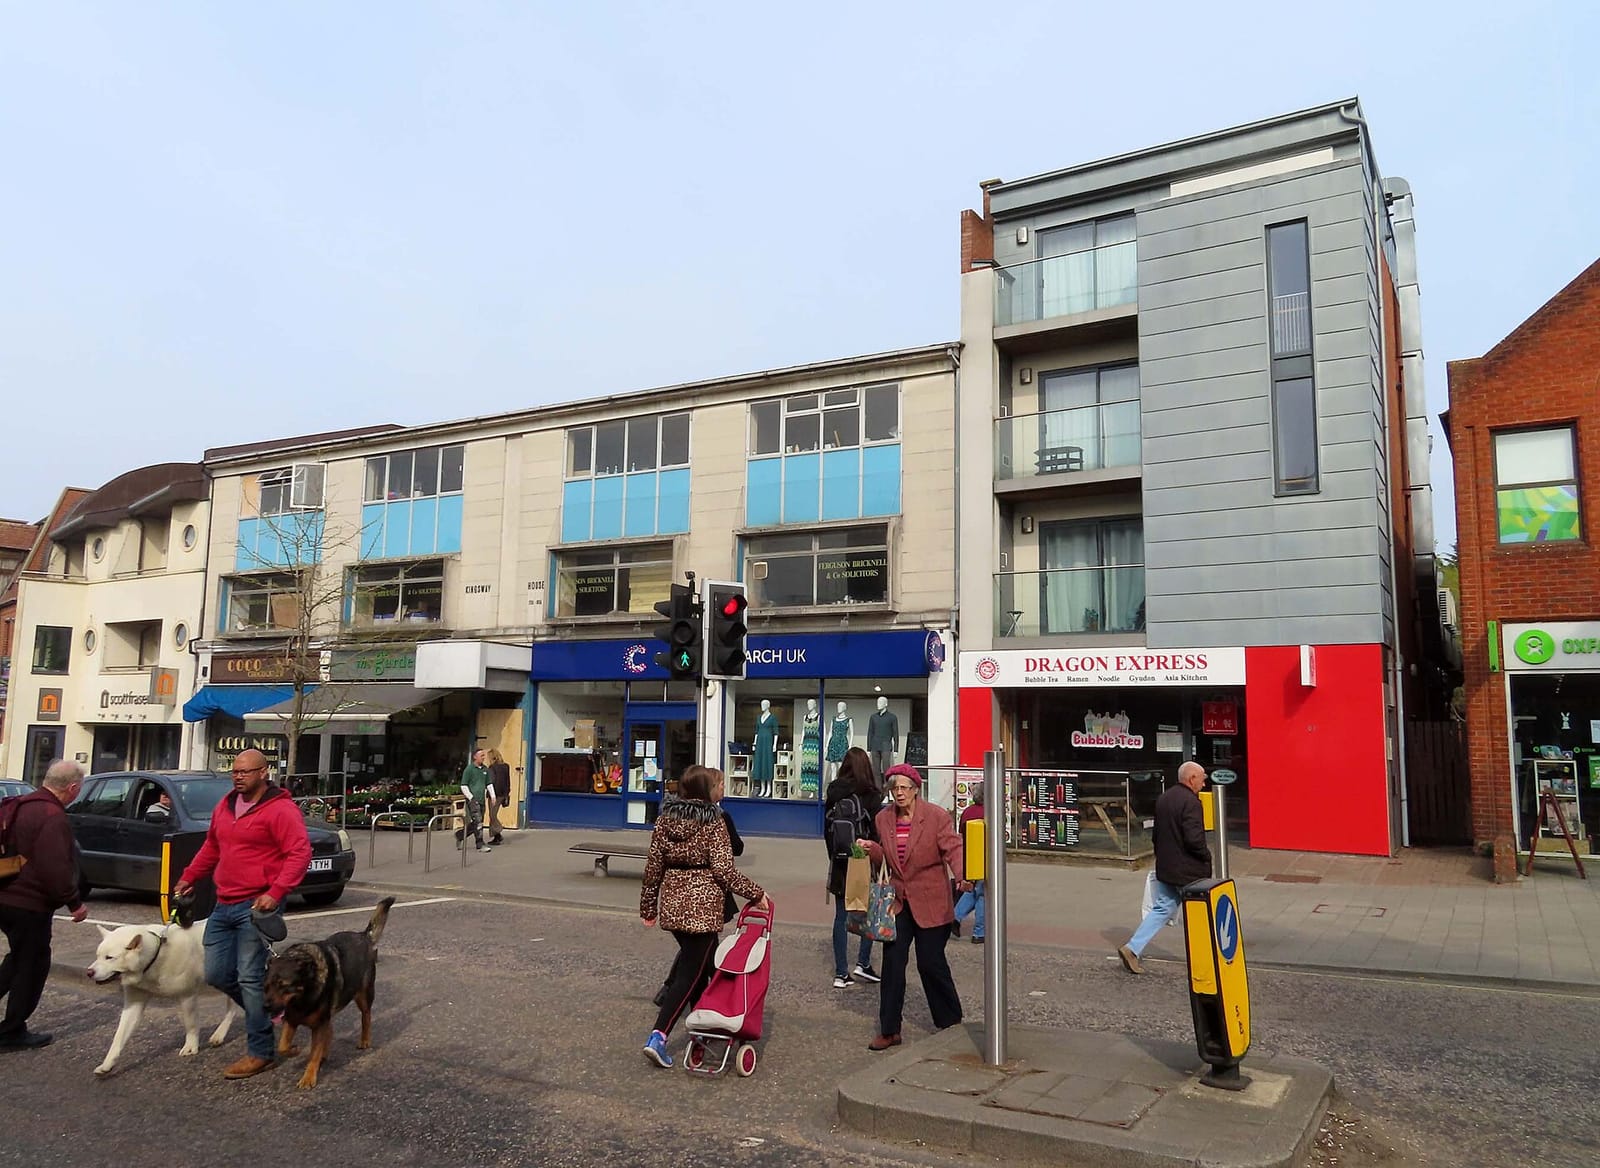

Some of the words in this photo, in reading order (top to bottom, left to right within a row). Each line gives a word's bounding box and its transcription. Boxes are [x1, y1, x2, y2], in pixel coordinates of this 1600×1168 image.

[818, 560, 851, 570] FERGUSON
[852, 558, 887, 568] BRICKNELL
[841, 569, 879, 579] SOLICITORS
[465, 585, 491, 593] KINGSWAY
[528, 581, 545, 590] HOUSE
[1562, 638, 1600, 655] OXF
[786, 648, 806, 663] UK
[227, 659, 262, 672] COCO
[1024, 656, 1108, 673] DRAGON
[1114, 654, 1208, 671] EXPRESS
[1128, 674, 1156, 683] Gyudon
[1180, 673, 1208, 681] Kitchen
[110, 690, 149, 705] scottfrase
[218, 736, 249, 750] COCO
[1073, 733, 1114, 746] Bubble
[1118, 734, 1141, 746] Tea
[314, 860, 330, 869] TYH
